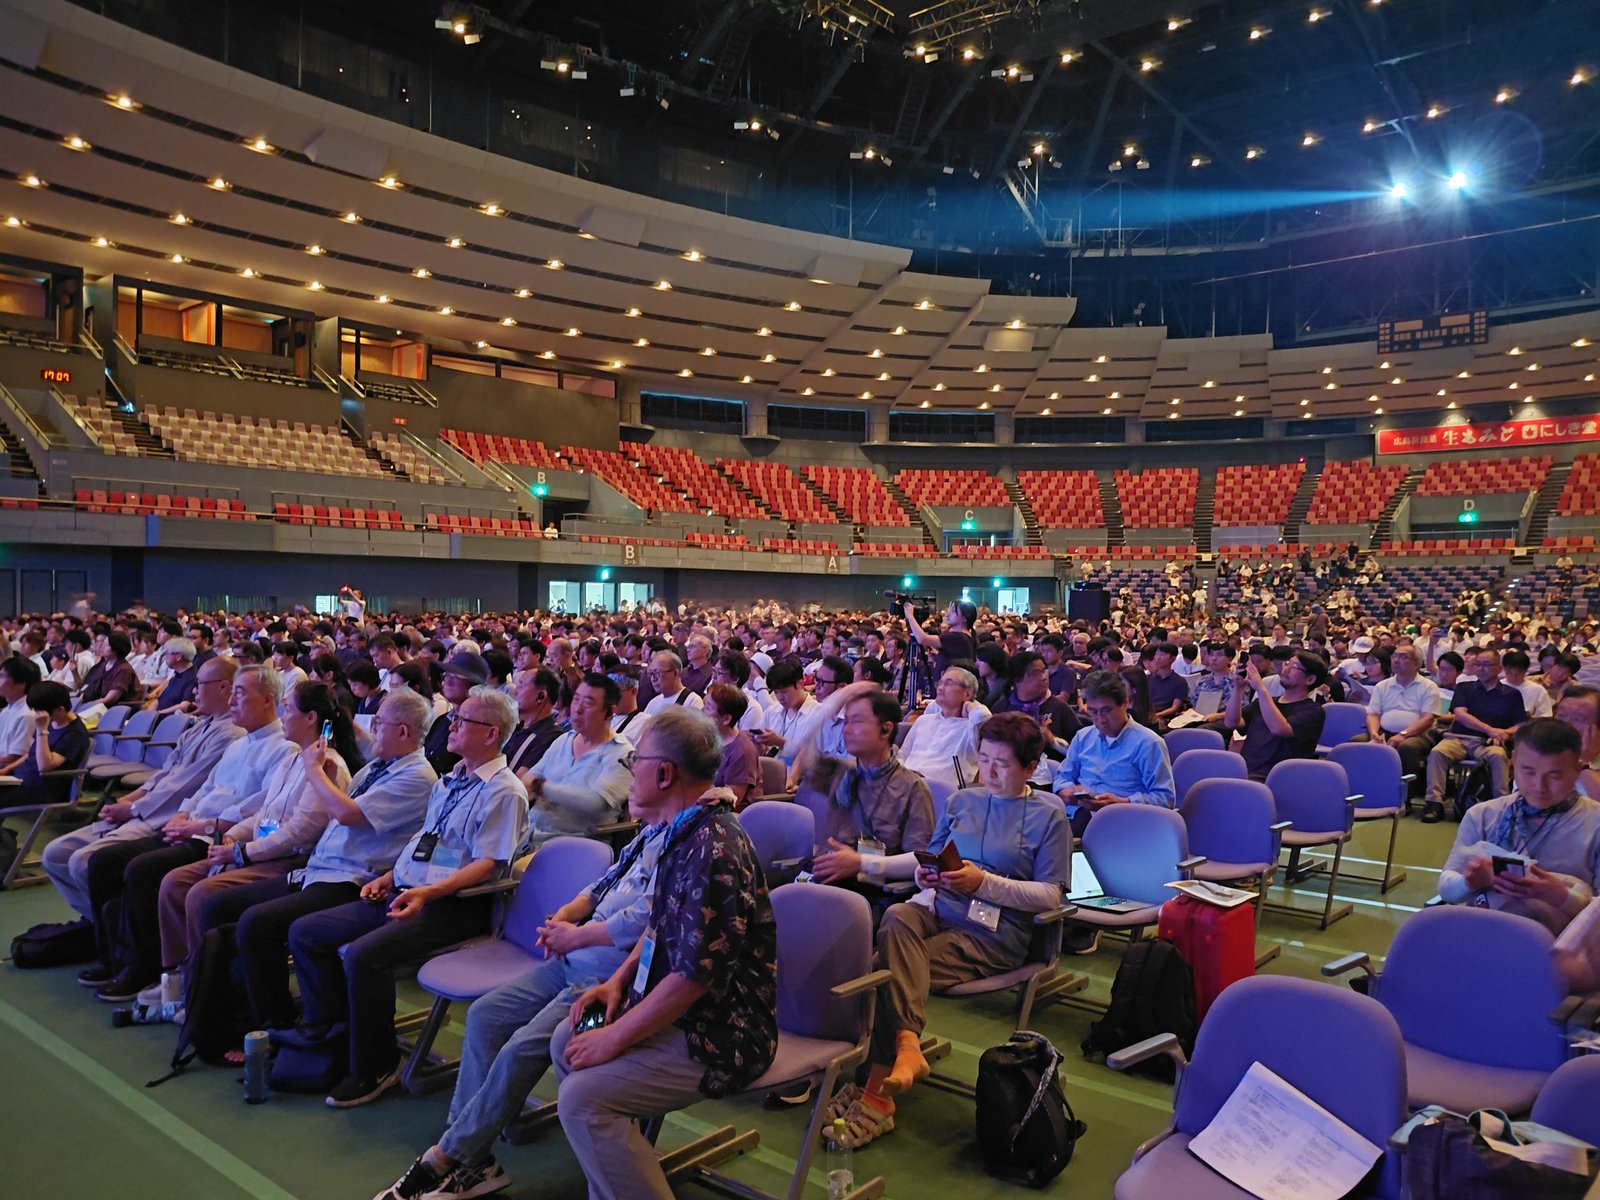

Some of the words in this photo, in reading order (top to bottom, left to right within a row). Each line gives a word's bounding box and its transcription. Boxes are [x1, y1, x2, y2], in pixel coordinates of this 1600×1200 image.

[1540, 420, 1598, 438] にしき堂
[537, 471, 546, 484] B
[1463, 499, 1475, 511] D
[965, 510, 974, 521] C
[625, 544, 635, 559] B
[828, 556, 837, 568] A
